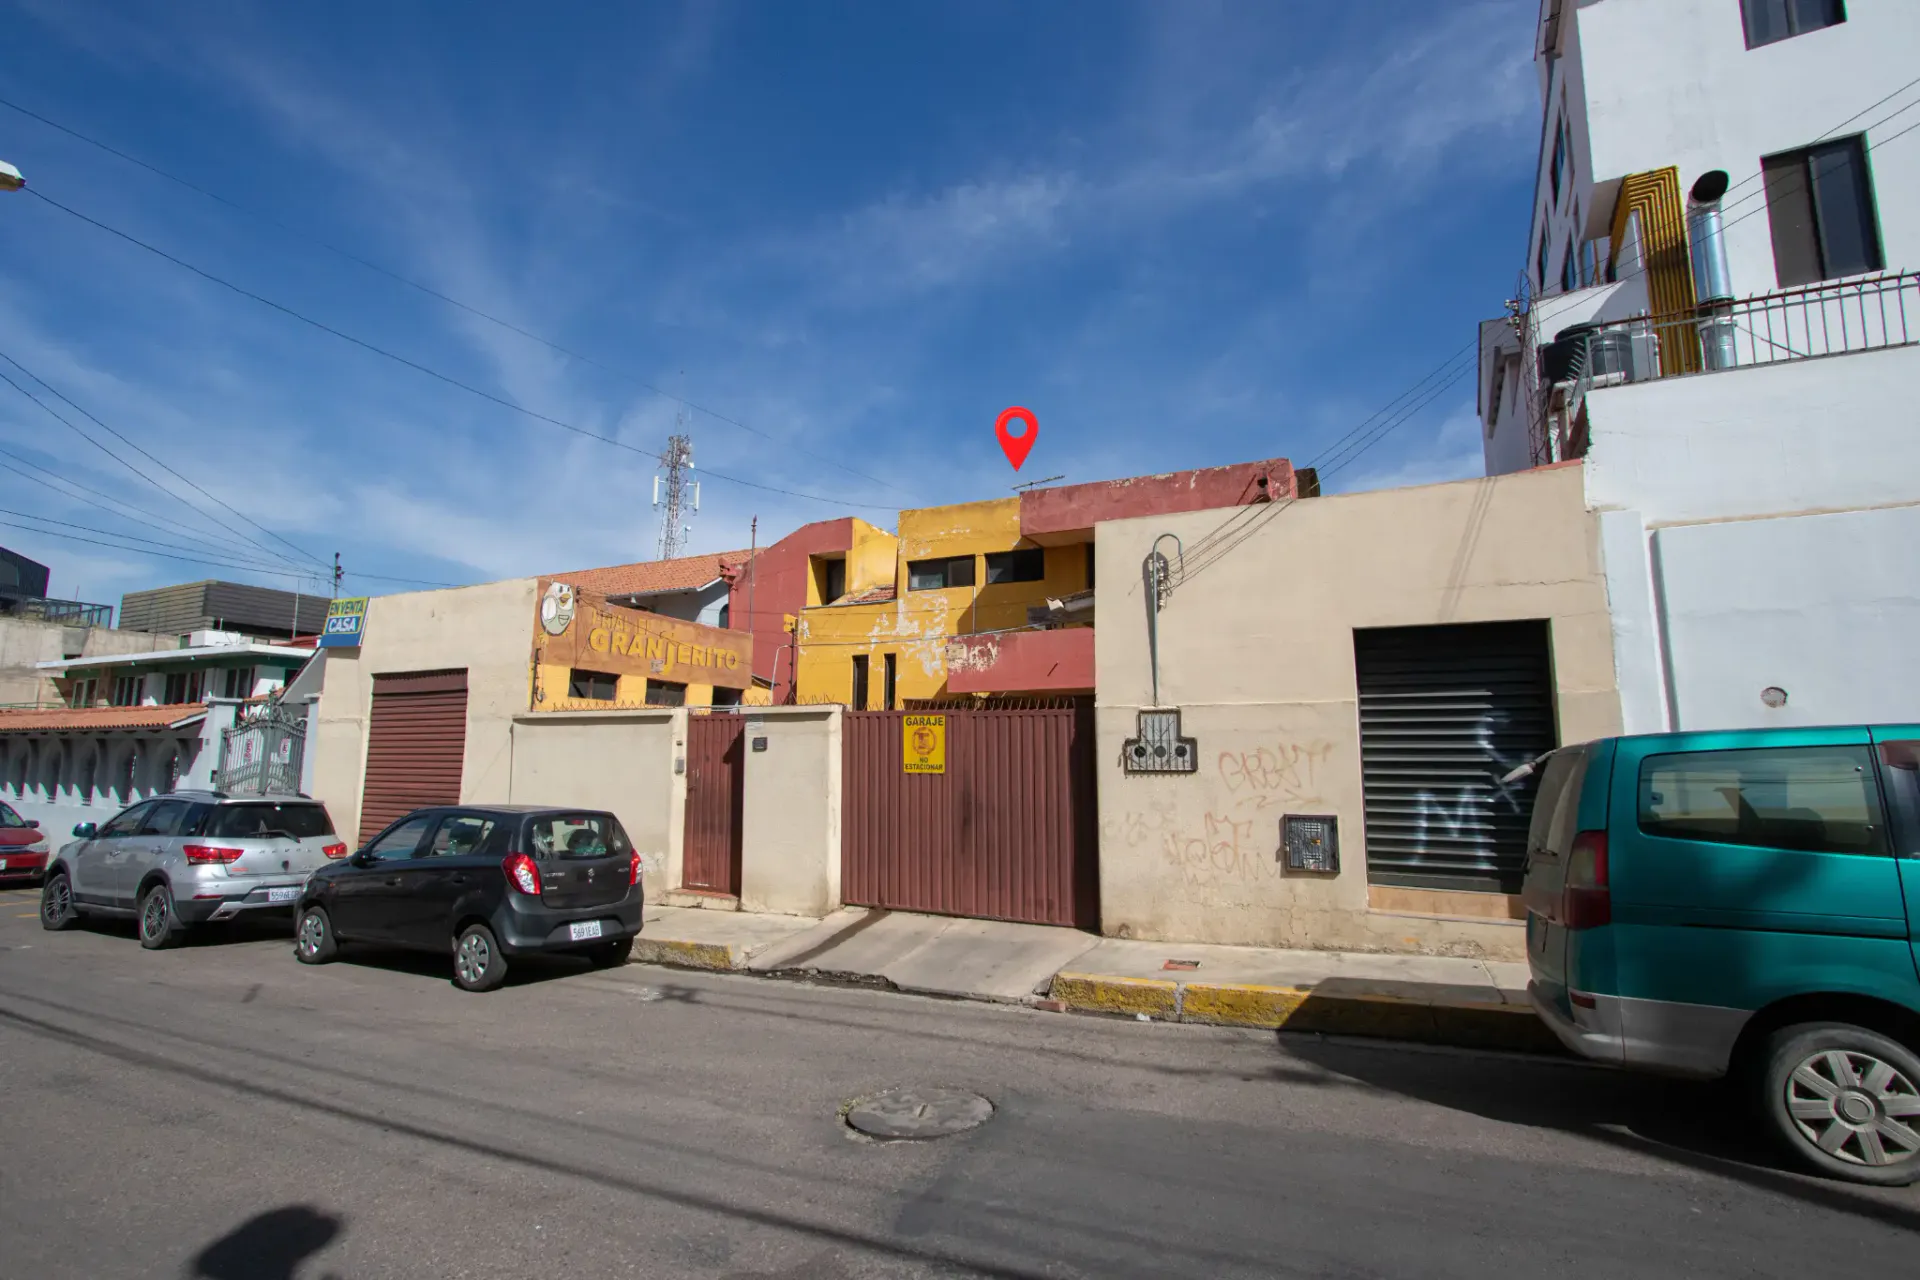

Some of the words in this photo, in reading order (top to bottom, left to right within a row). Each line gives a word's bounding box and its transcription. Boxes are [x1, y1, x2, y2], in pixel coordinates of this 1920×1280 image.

[330, 602, 339, 615] EN
[340, 600, 364, 614] VENTA
[328, 617, 356, 633] CASA
[589, 627, 740, 676] GRANJERITO
[905, 717, 944, 726] GARAJE
